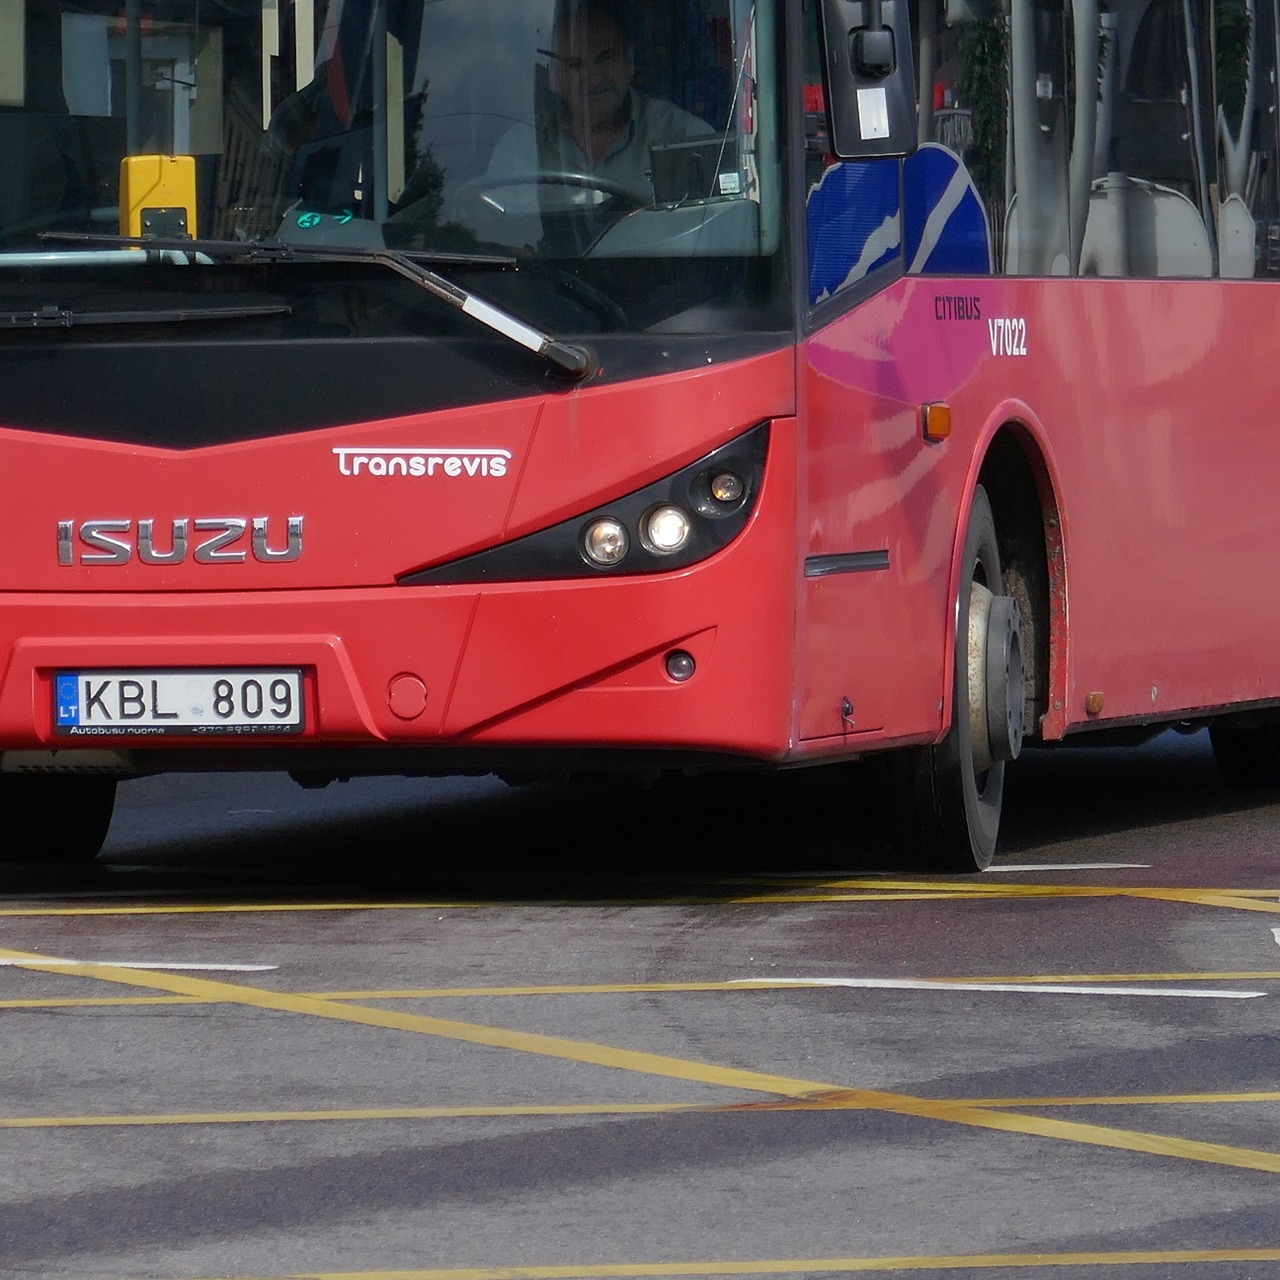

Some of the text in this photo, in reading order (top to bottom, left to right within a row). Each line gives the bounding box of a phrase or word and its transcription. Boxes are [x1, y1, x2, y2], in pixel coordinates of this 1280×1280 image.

[934, 296, 981, 320] CITIBUS
[988, 318, 1027, 357] V7022
[332, 448, 512, 477] Transrevis
[57, 516, 305, 567] ISUZU
[59, 705, 79, 718] LT
[84, 678, 293, 721] KBL 809
